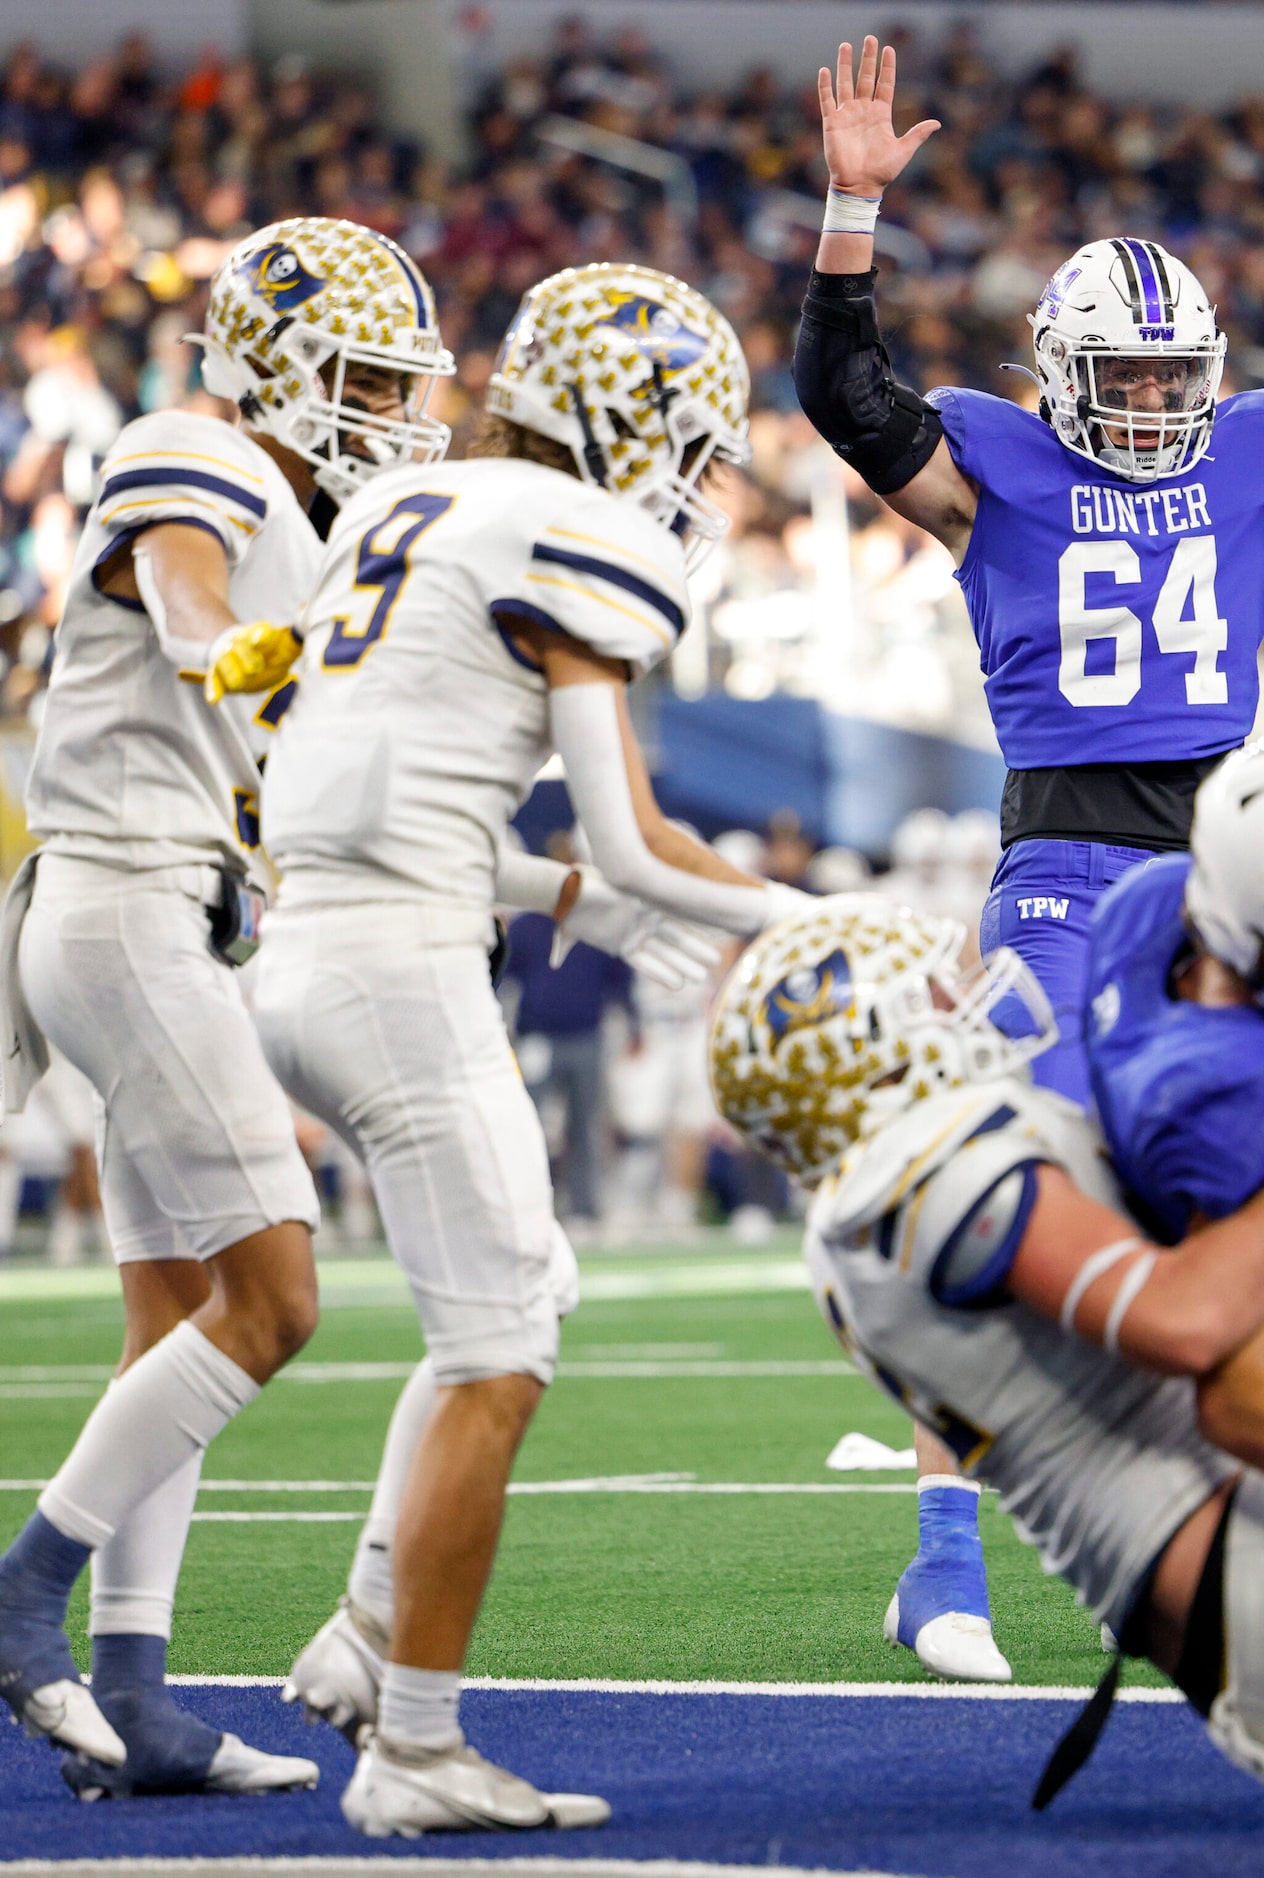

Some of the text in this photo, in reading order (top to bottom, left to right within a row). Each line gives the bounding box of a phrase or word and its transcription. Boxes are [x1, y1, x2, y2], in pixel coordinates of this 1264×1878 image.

[1138, 327, 1175, 341] TPW
[1070, 482, 1212, 536] GUNTER
[321, 490, 459, 675] 9
[1058, 534, 1229, 708] 64
[1016, 897, 1070, 921] TPW
